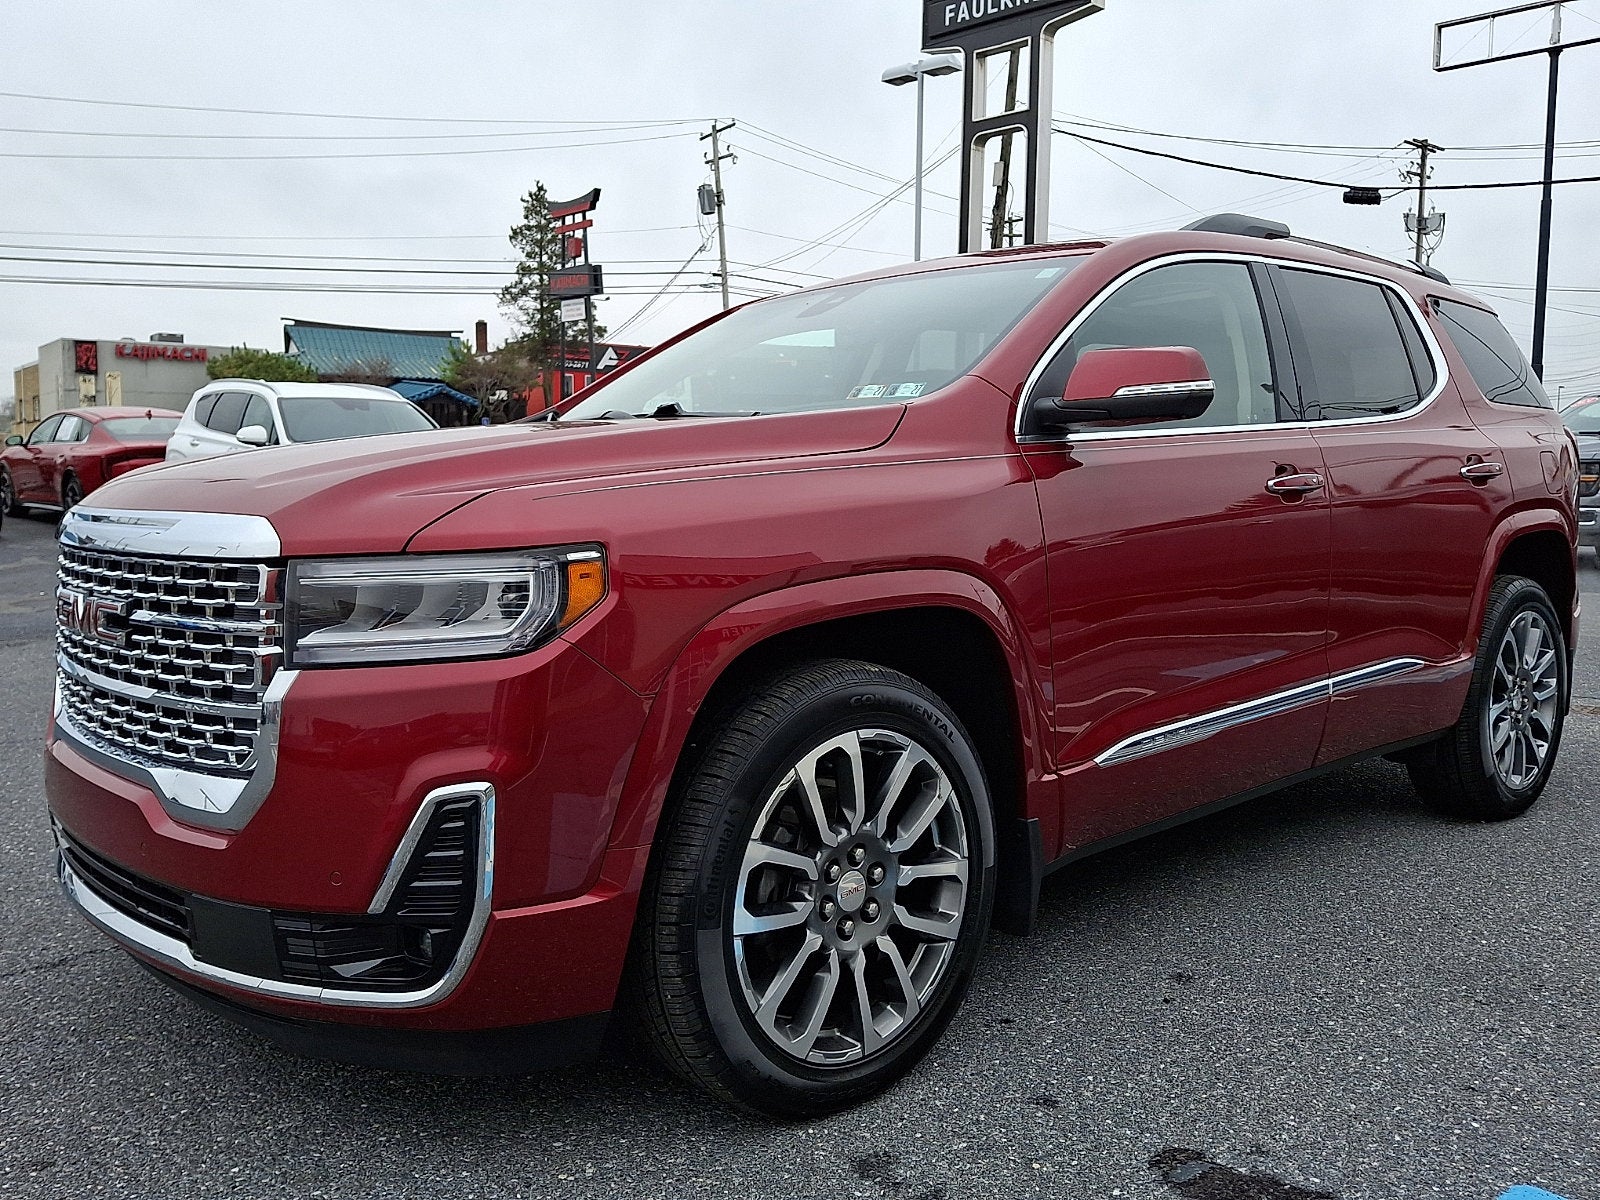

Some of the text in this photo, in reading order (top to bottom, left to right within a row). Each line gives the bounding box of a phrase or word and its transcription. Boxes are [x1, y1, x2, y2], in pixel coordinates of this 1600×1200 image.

[944, 0, 1039, 26] FAULK
[115, 344, 208, 361] KAJIMACHI
[911, 384, 923, 395] 27
[57, 587, 126, 645] GMC
[849, 693, 955, 744] COENTAL
[840, 883, 865, 900] GMC
